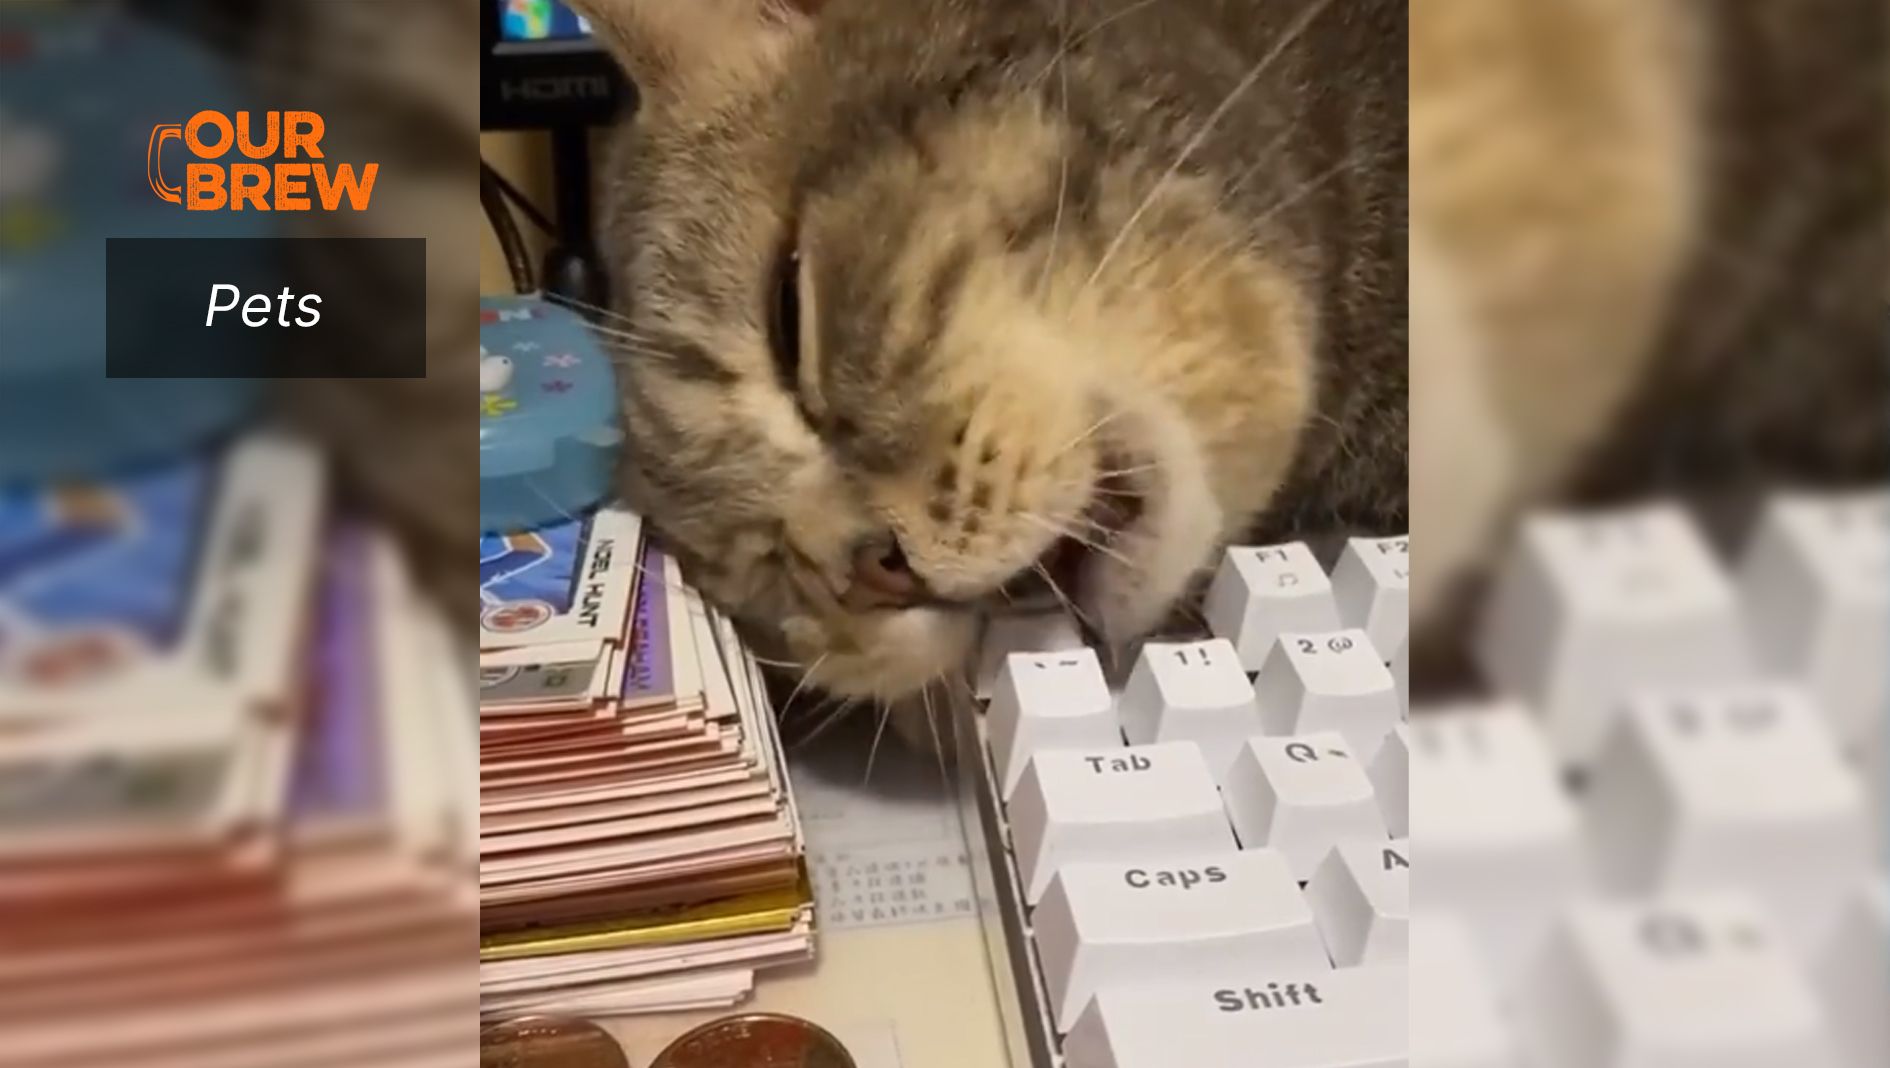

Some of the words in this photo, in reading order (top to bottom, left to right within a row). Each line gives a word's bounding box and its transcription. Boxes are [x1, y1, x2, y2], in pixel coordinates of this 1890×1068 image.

[588, 538, 615, 580] NOEL
[1255, 549, 1288, 562] F1
[1377, 540, 1409, 555] F2
[577, 583, 605, 628] HUNT
[1084, 753, 1152, 774] Tab
[1284, 741, 1320, 764] Q
[1382, 848, 1409, 871] A
[1124, 865, 1228, 891] Caps
[1212, 981, 1323, 1013] Shift
